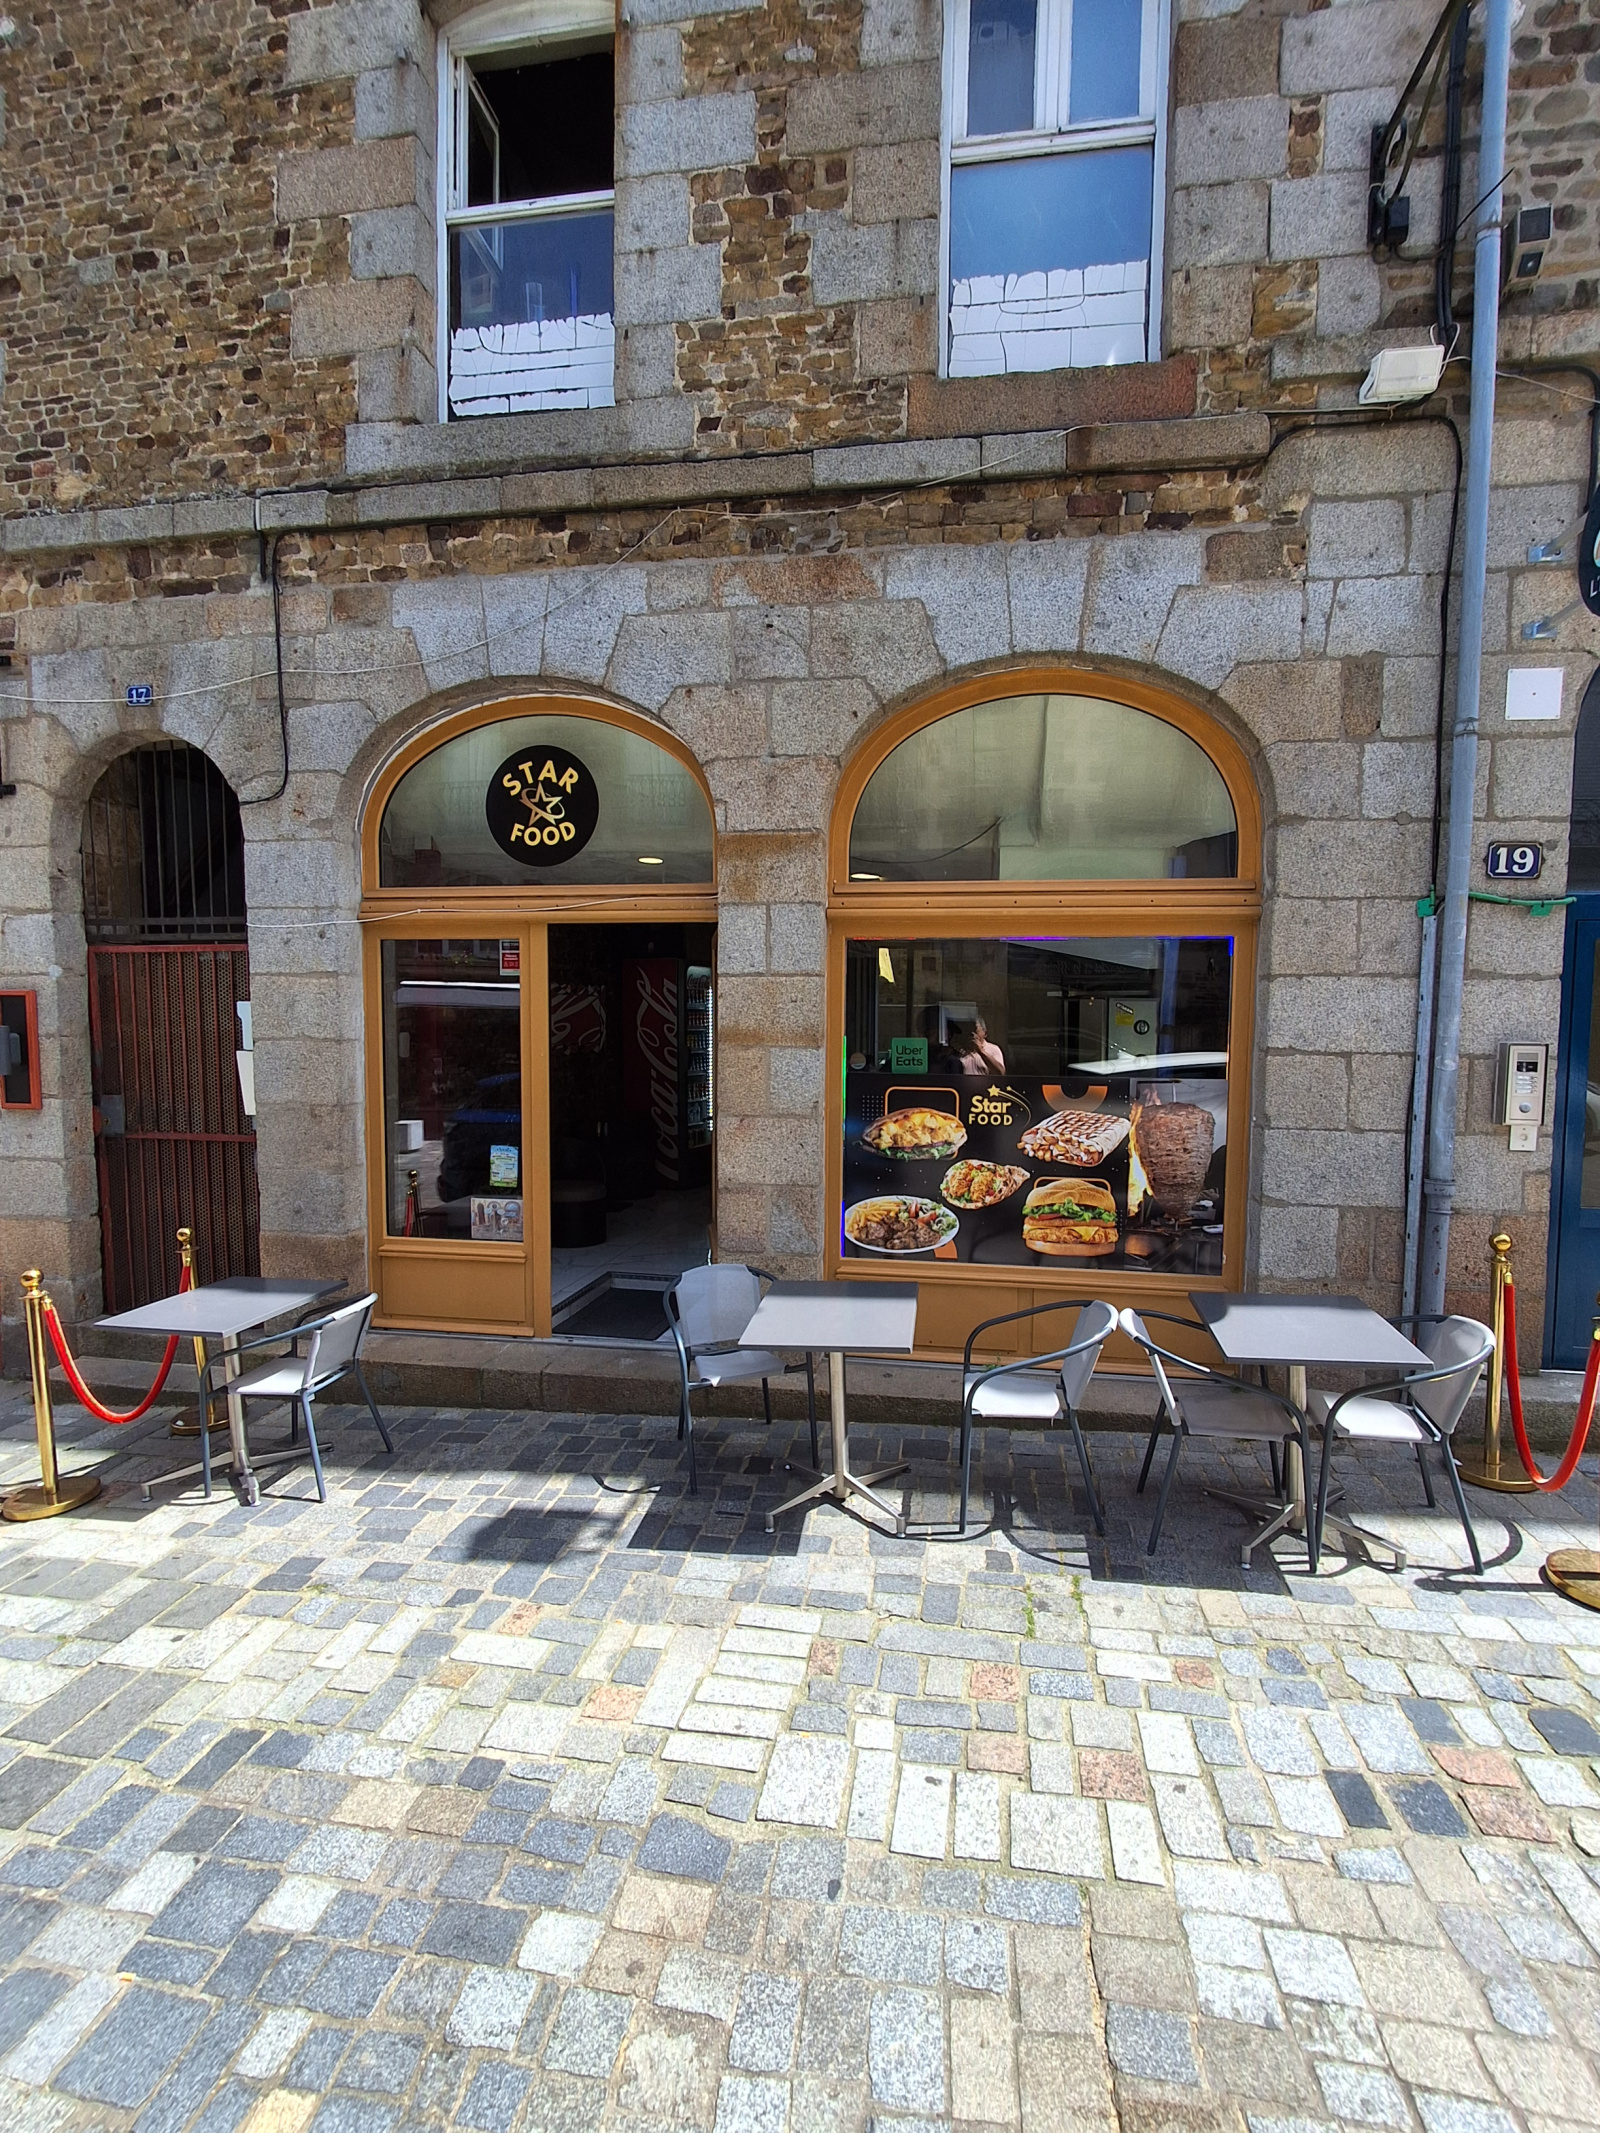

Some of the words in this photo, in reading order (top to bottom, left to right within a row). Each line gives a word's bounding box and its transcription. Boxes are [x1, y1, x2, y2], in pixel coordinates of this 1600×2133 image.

[131, 689, 147, 703] 17
[502, 759, 579, 797] STAR
[510, 821, 576, 847] FOOD
[1495, 847, 1534, 873] 19
[896, 1045, 923, 1056] Uber
[896, 1056, 924, 1067] Eats
[970, 1095, 1012, 1113] Star
[968, 1113, 1013, 1126] FOOD
